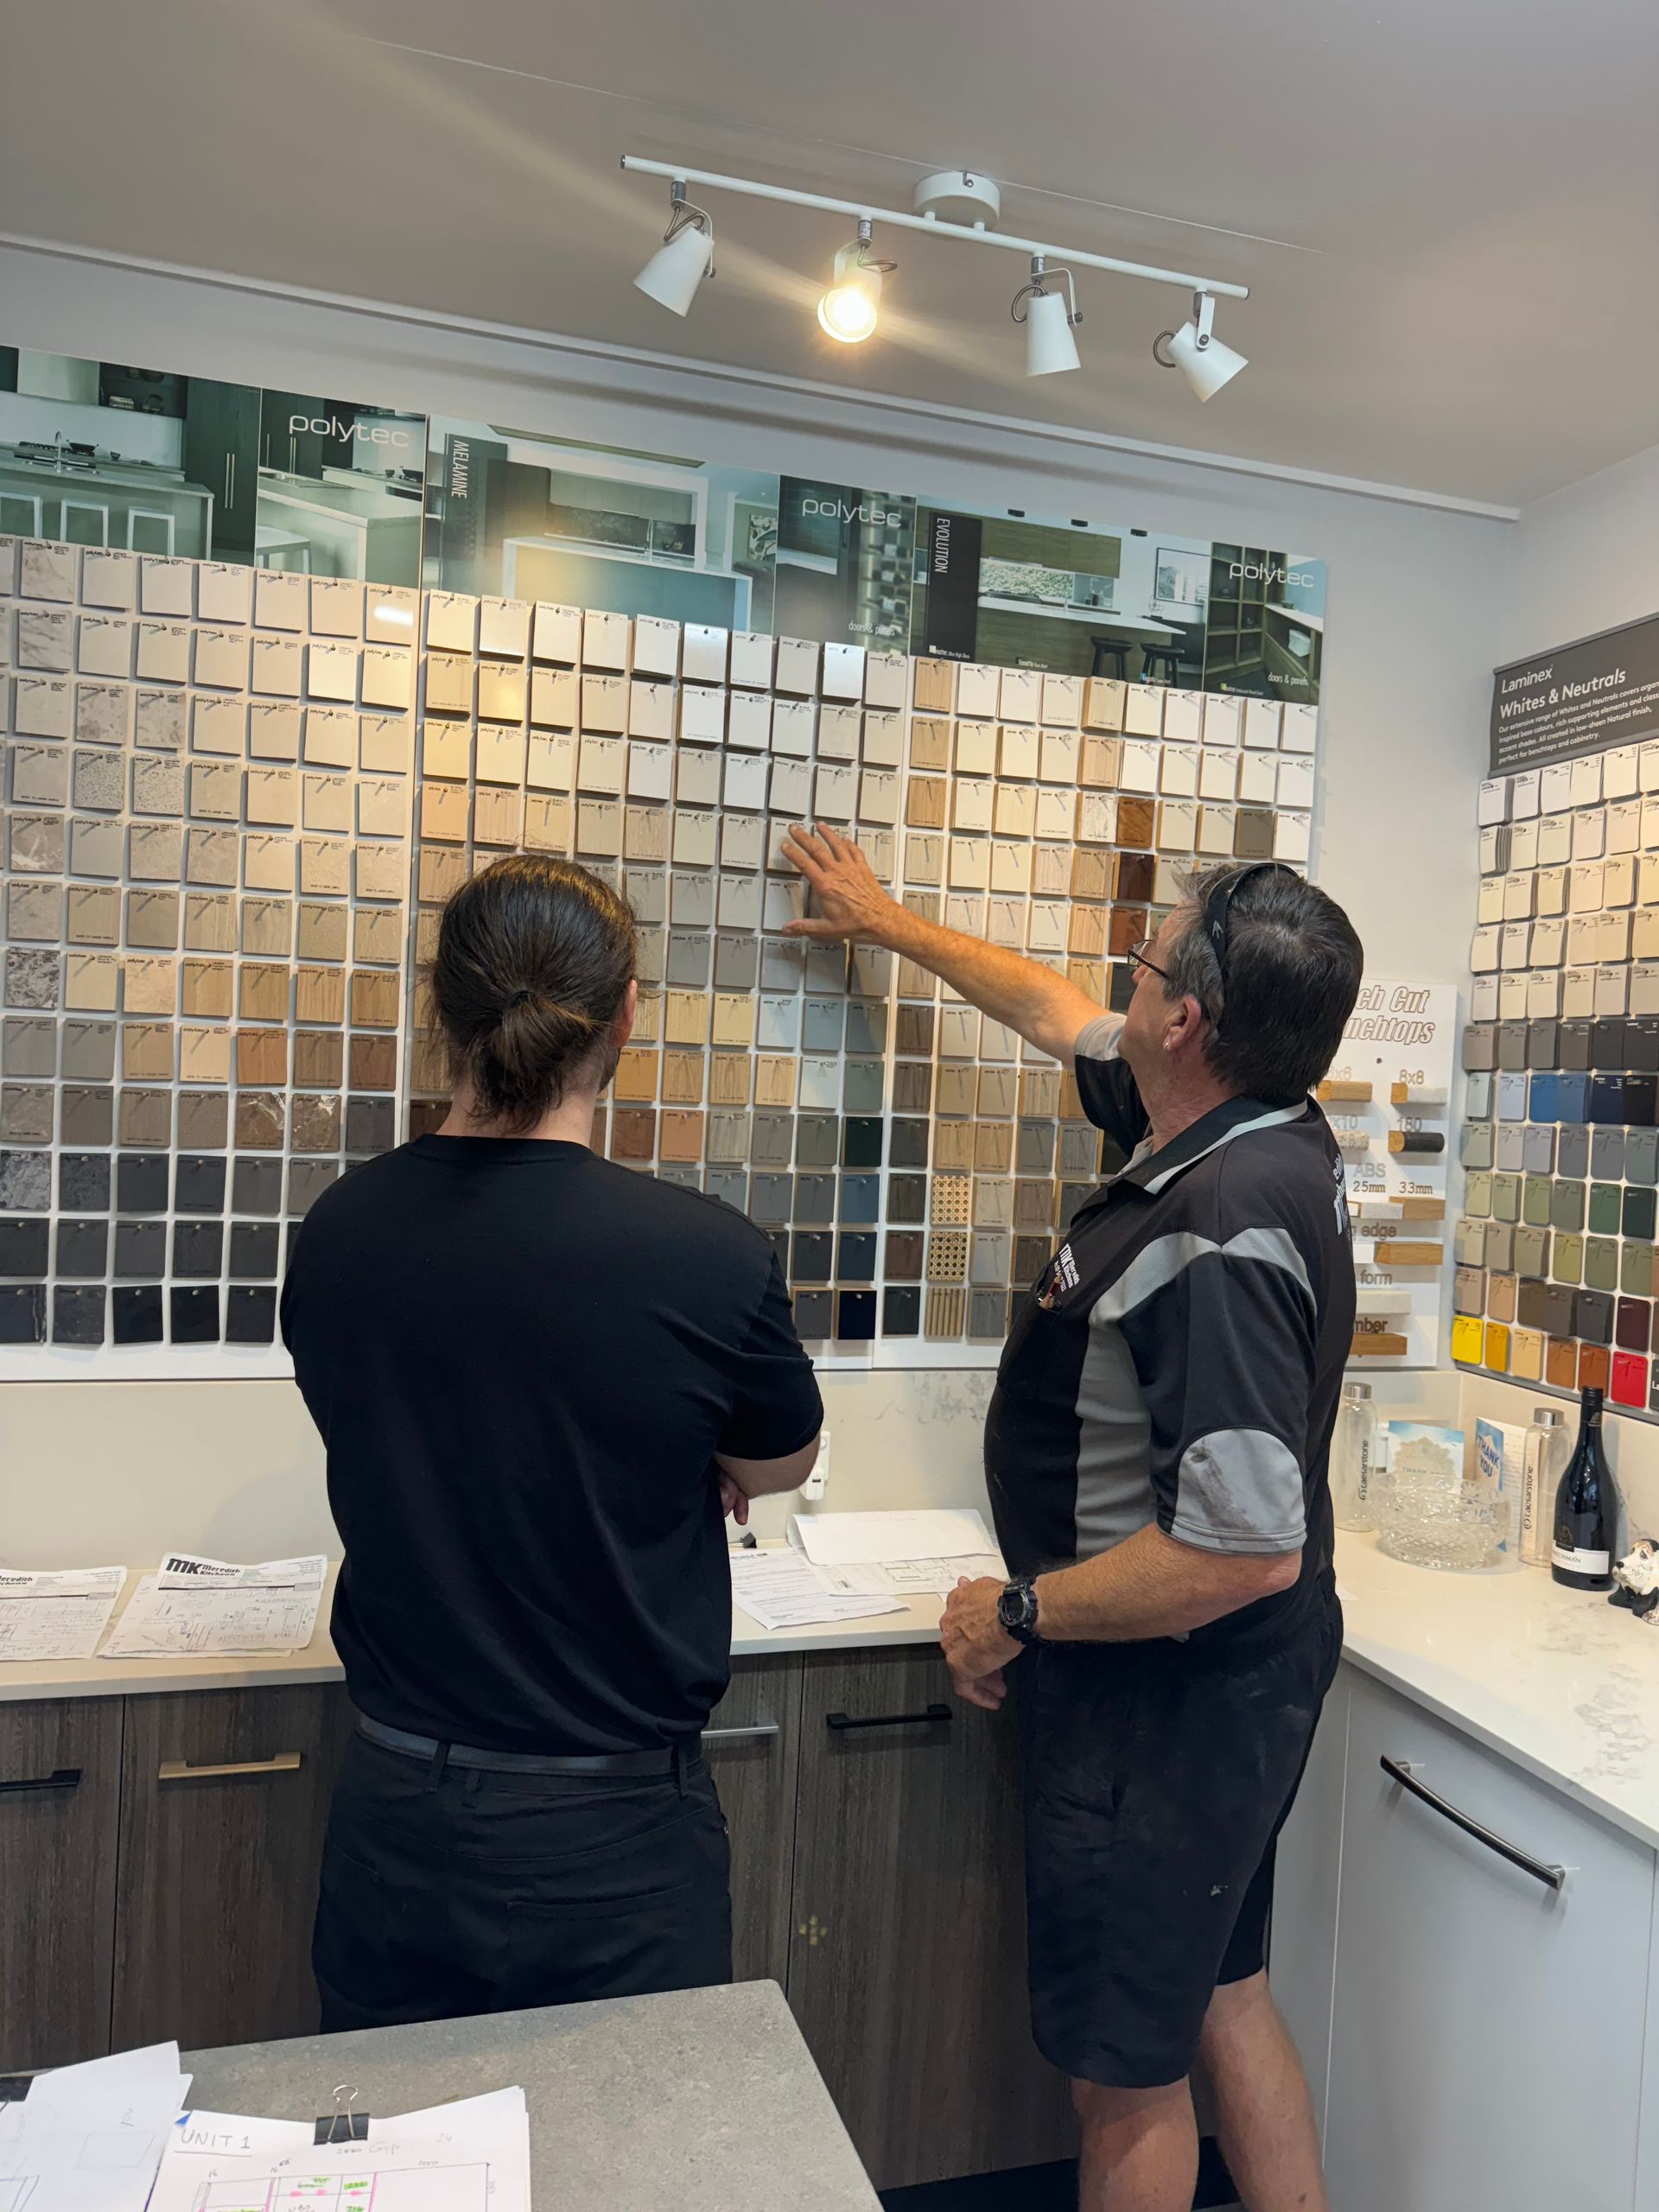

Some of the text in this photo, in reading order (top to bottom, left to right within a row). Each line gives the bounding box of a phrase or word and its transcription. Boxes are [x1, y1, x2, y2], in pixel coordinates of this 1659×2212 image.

[289, 415, 409, 447] polytec
[451, 439, 469, 499] MELAMINE
[802, 499, 902, 528] polytec
[934, 518, 950, 574] EVOLUTION
[1230, 563, 1314, 588] polytec
[849, 619, 865, 632] doors
[867, 622, 874, 633] &
[1268, 671, 1308, 687] doors & panels
[1502, 667, 1553, 694] Laminex
[1500, 668, 1626, 720] Whites & Neutrals
[1498, 724, 1509, 734] Our
[1510, 718, 1535, 731] extensive
[1535, 714, 1551, 725] range
[1559, 705, 1580, 716] Whites
[1580, 701, 1592, 710] and
[1592, 693, 1618, 706] Neutrals
[1619, 688, 1640, 698] covers
[1498, 732, 1520, 744] inspired
[1520, 729, 1534, 739] base
[1555, 718, 1567, 728] rich
[1567, 709, 1599, 725] supporting
[1599, 702, 1629, 716] elements
[1629, 696, 1642, 706] and
[1498, 743, 1517, 753] accent
[1517, 738, 1538, 750] shades.
[1538, 734, 1547, 743] All
[1547, 728, 1569, 741] created
[1576, 720, 1606, 733] low-sheen
[1606, 712, 1631, 724] Natural
[1498, 731, 1600, 766] perfect for benchtops and cabinetry.
[1389, 986, 1431, 1014] Cut
[1399, 1069, 1425, 1084] 8x8
[1396, 1116, 1422, 1132] 180
[1353, 1163, 1386, 1178] ABS
[1352, 1180, 1386, 1193] 25mm
[1399, 1181, 1433, 1194] 33mm
[1361, 1224, 1397, 1240] edge
[1478, 1434, 1500, 1467] THANK
[1479, 1455, 1493, 1478] YOU
[1524, 1465, 1534, 1517] caesarstone
[165, 1558, 240, 1575] MK Meredith
[181, 2128, 251, 2149] UNIT 1
